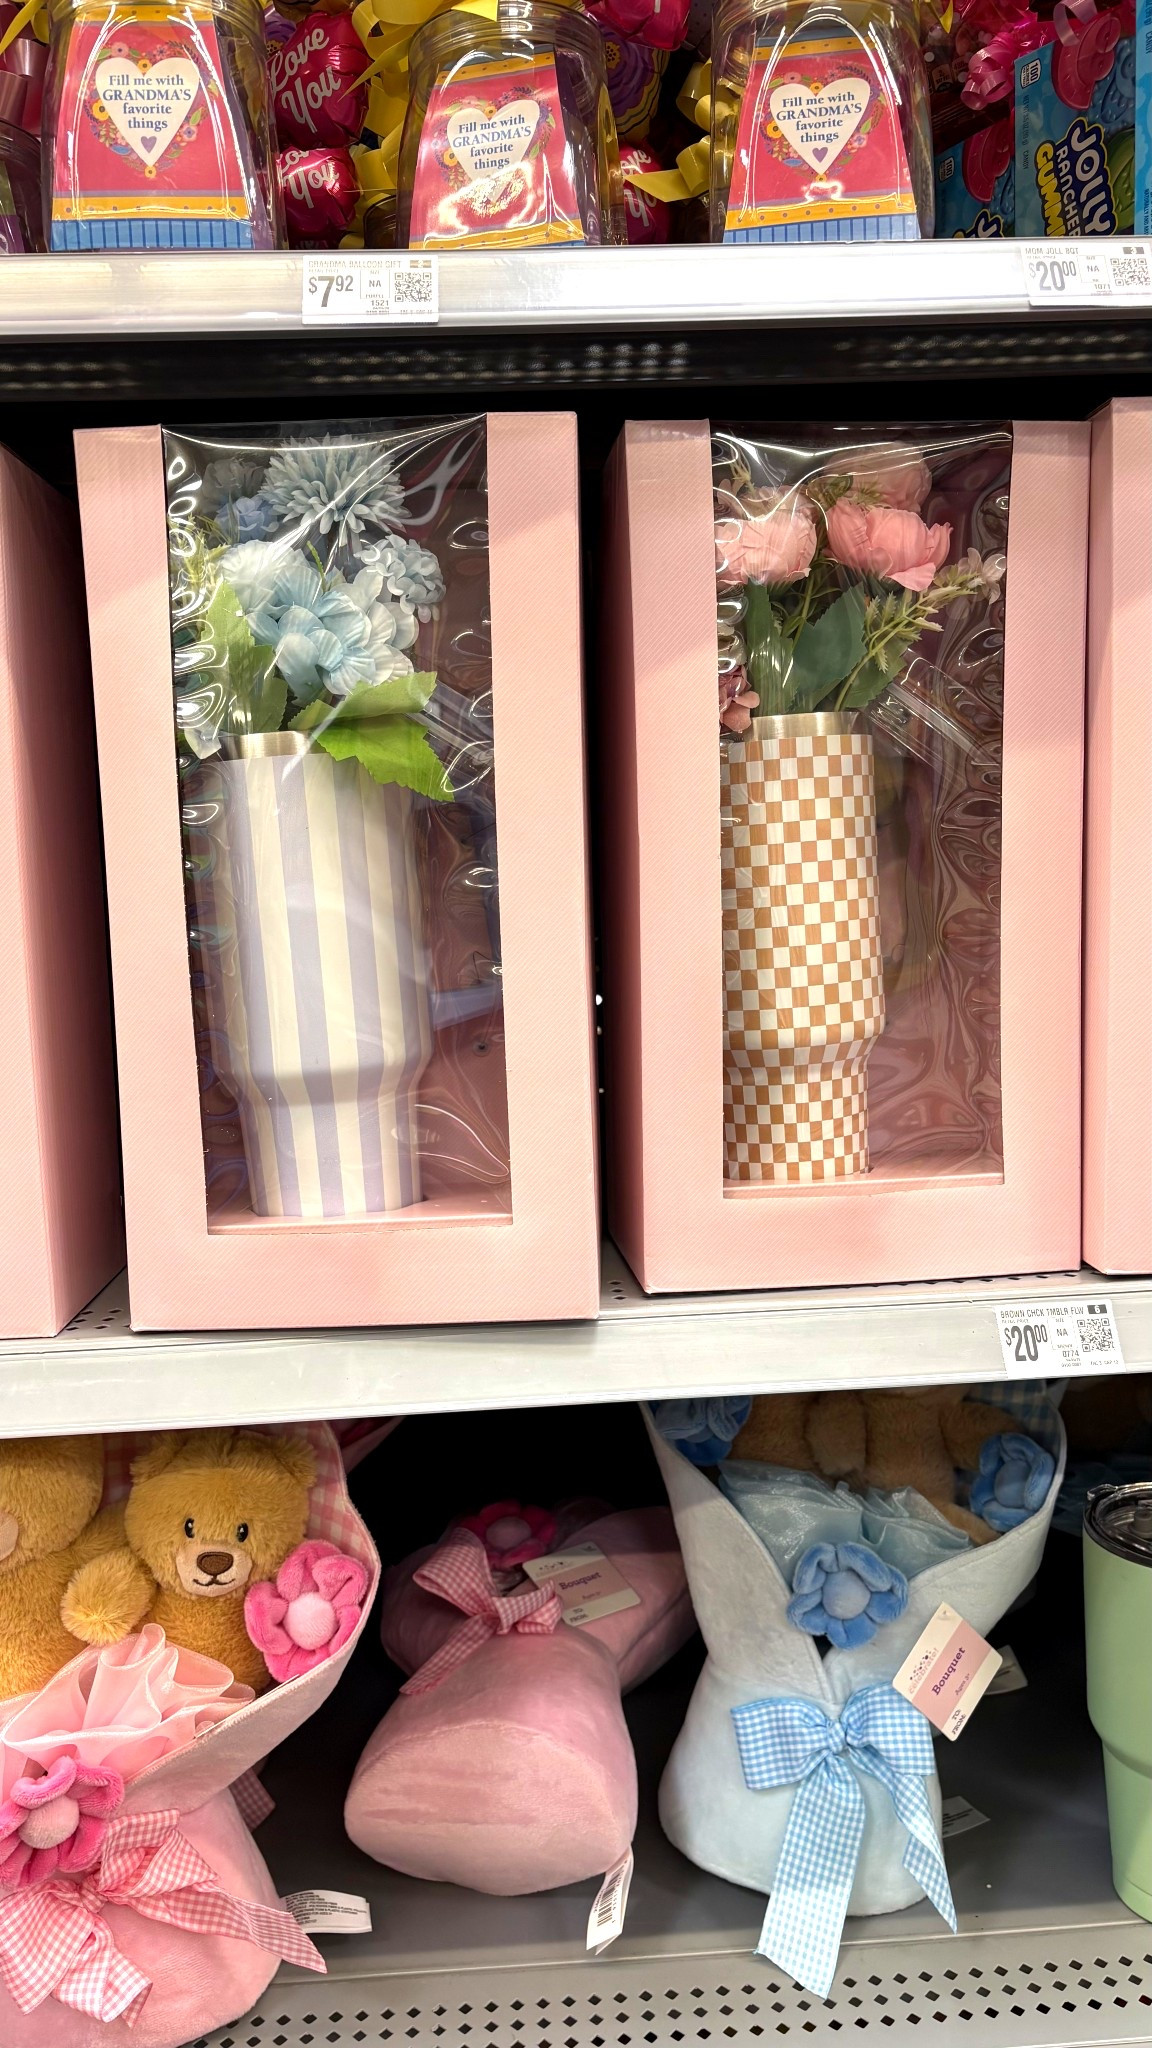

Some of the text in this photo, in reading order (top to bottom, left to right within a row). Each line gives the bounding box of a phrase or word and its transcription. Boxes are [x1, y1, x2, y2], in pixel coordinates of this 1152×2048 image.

[270, 28, 329, 99] Love
[1030, 62, 1039, 82] 100
[109, 74, 184, 86] Fill me with
[102, 88, 192, 101] GRANDMA'S
[281, 65, 342, 134] You
[782, 91, 855, 108] Fill me with
[123, 102, 172, 115] favorite
[776, 103, 862, 121] GRANDMA'S
[128, 117, 168, 132] things
[459, 114, 525, 134] Fill me with
[796, 118, 844, 131] favorite
[453, 125, 532, 148] GRANDMA'S
[800, 131, 839, 144] things
[470, 143, 514, 158] favorite
[474, 157, 510, 170] things
[283, 161, 339, 209] You
[1071, 127, 1111, 233] JOLLY
[385, 260, 402, 269] GIFT
[368, 279, 382, 288] NA
[1000, 1309, 1025, 1319] BROWN
[1027, 1309, 1045, 1317] CHCK
[1046, 1307, 1069, 1316] TMBLR
[1094, 1305, 1101, 1314] 6
[1056, 1328, 1069, 1337] NA
[559, 1572, 602, 1590] Bouquet
[931, 1646, 966, 1696] Bouquet
